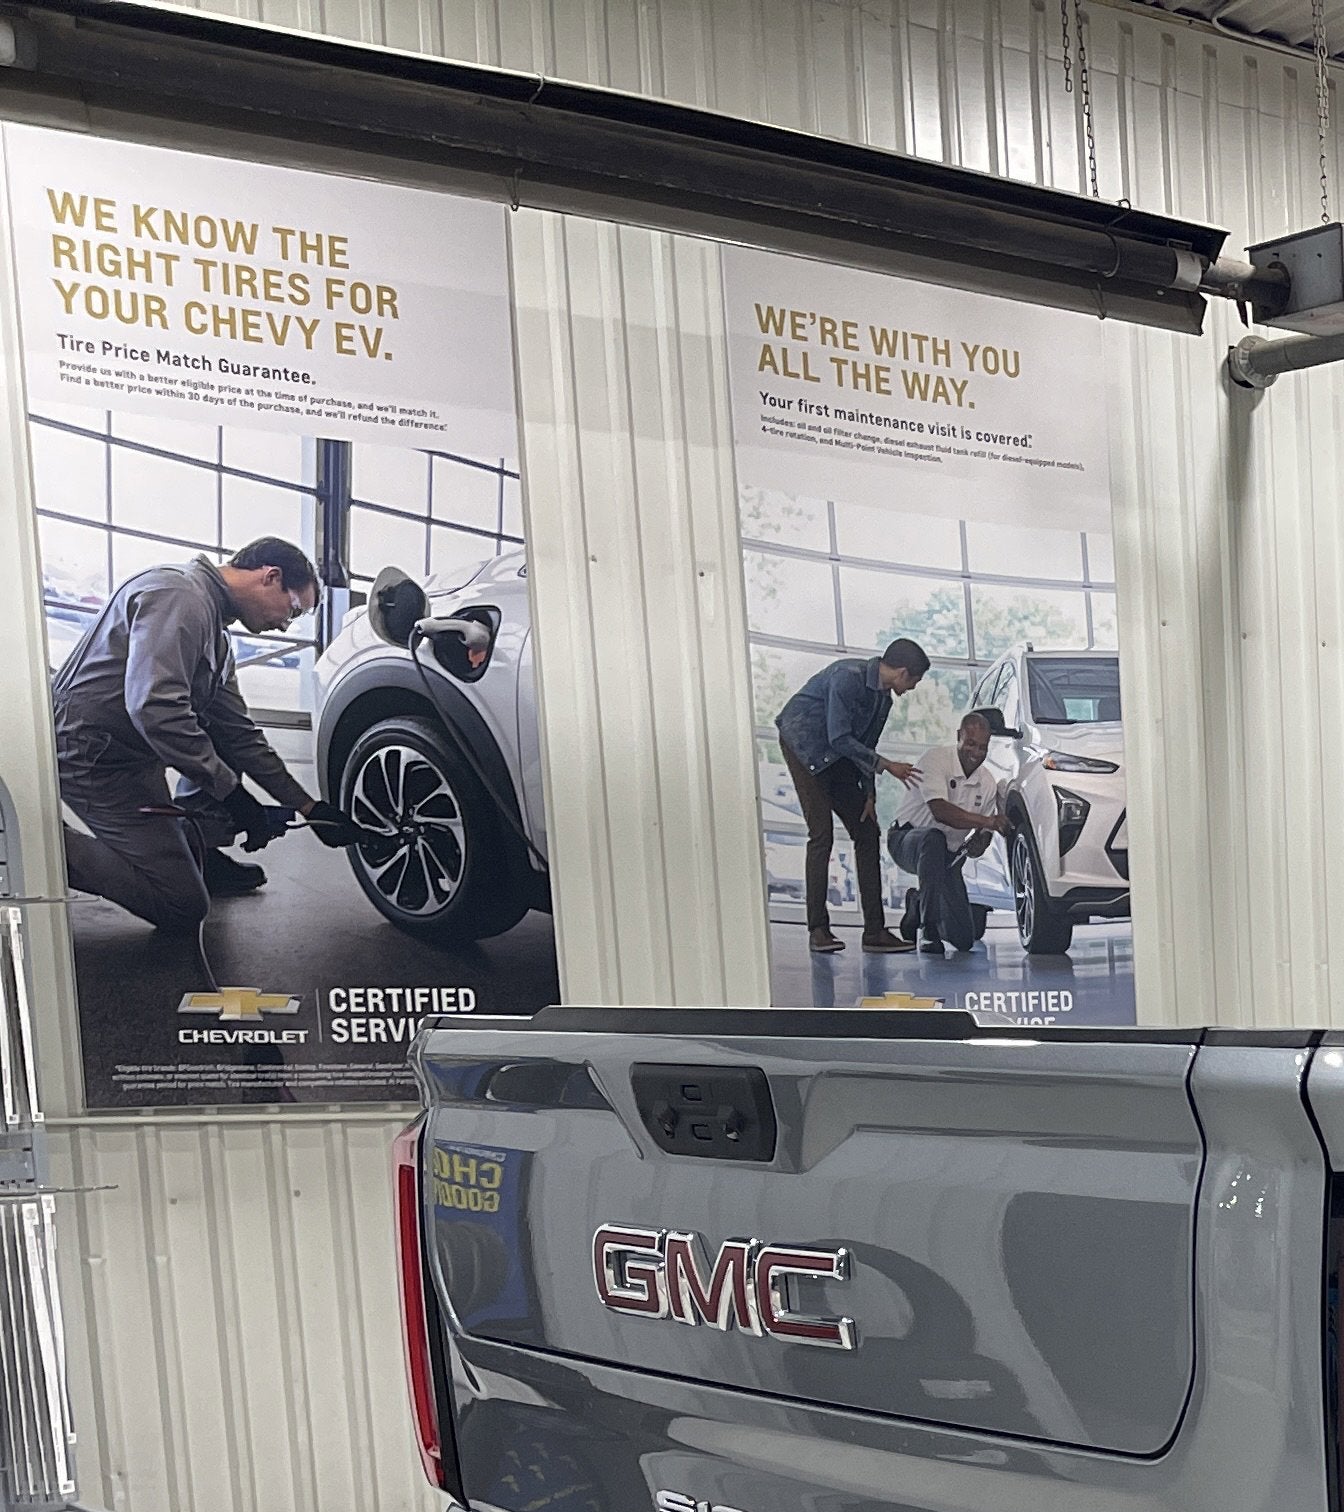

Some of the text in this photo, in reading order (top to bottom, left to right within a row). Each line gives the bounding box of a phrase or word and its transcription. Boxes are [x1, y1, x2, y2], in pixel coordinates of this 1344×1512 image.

[46, 187, 350, 270] WE KNOW THE
[52, 233, 399, 320] RIGHT TIRES FOR
[51, 278, 393, 361] YOUR CHEVY EV.
[754, 302, 1021, 379] WE'RE WITH YOU
[56, 333, 317, 385] Tire Price Match Guarantee.
[758, 343, 975, 410] ALL THE WAY.
[58, 360, 98, 374] Provide
[100, 367, 112, 376] us
[115, 369, 137, 381] with
[148, 373, 178, 386] better
[181, 379, 215, 392] eligible
[218, 384, 242, 396] price
[245, 388, 254, 396] at
[257, 388, 272, 398] the
[275, 391, 295, 401] time
[298, 394, 308, 403] of
[310, 396, 355, 410] purchase,
[358, 401, 374, 411] and
[399, 406, 427, 418] match
[60, 373, 82, 384] Find
[93, 378, 124, 390] better
[127, 384, 152, 395] price
[155, 386, 185, 399] within
[188, 391, 200, 401] 30
[202, 394, 225, 406] days
[227, 398, 237, 407] of
[239, 399, 255, 409] the
[257, 403, 303, 416] purchase,
[305, 407, 322, 417] and
[348, 412, 379, 424] refund
[381, 416, 396, 426] the
[759, 390, 793, 410] Your
[797, 398, 830, 418] first
[834, 407, 925, 433] maintenance
[928, 421, 958, 439] visit
[961, 425, 972, 441] is
[328, 987, 477, 1013] CERTIFIED
[964, 990, 1074, 1013] CERTIFIED
[178, 1029, 309, 1045] CHEVROLET
[330, 1017, 422, 1044] SERVI
[592, 1222, 859, 1351] GMC
